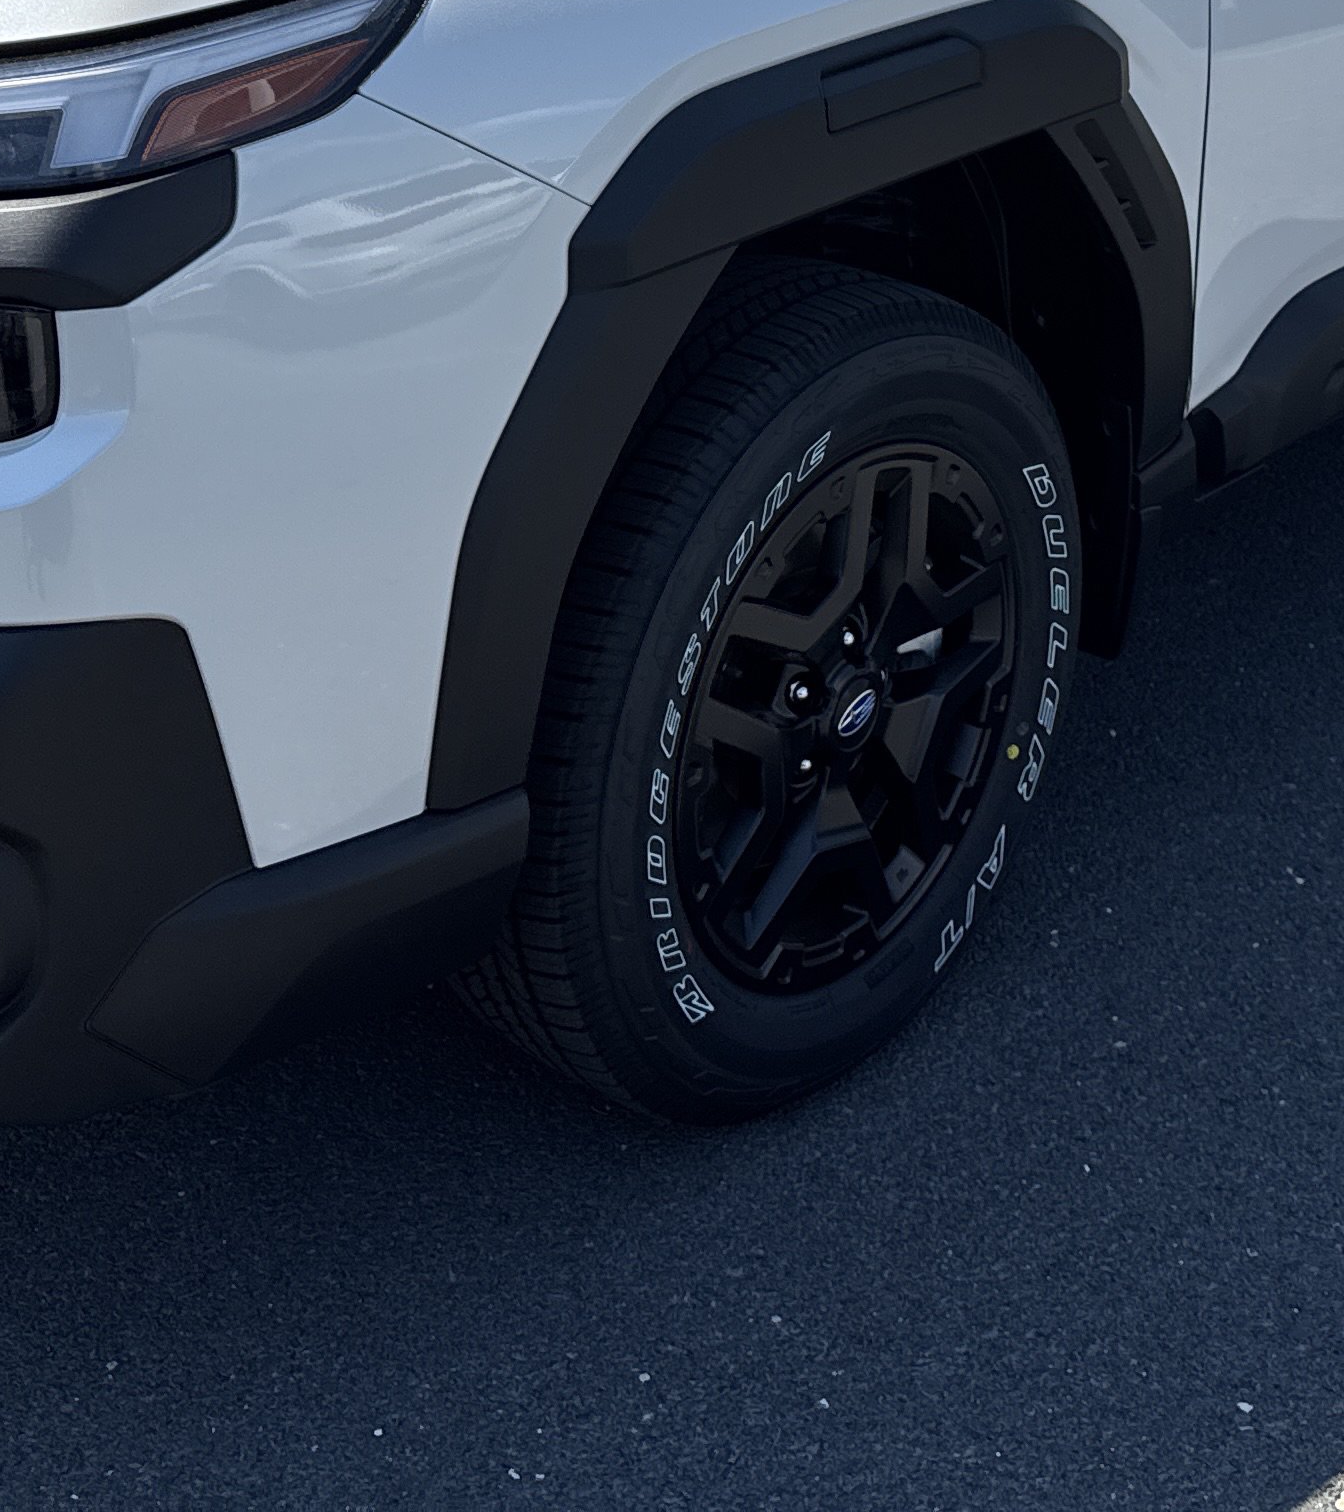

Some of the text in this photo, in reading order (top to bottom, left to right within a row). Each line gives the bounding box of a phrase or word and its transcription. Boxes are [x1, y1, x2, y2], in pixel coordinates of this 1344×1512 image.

[647, 429, 832, 1024] BRIDGESTONE
[934, 462, 1071, 974] DUELER A/T
